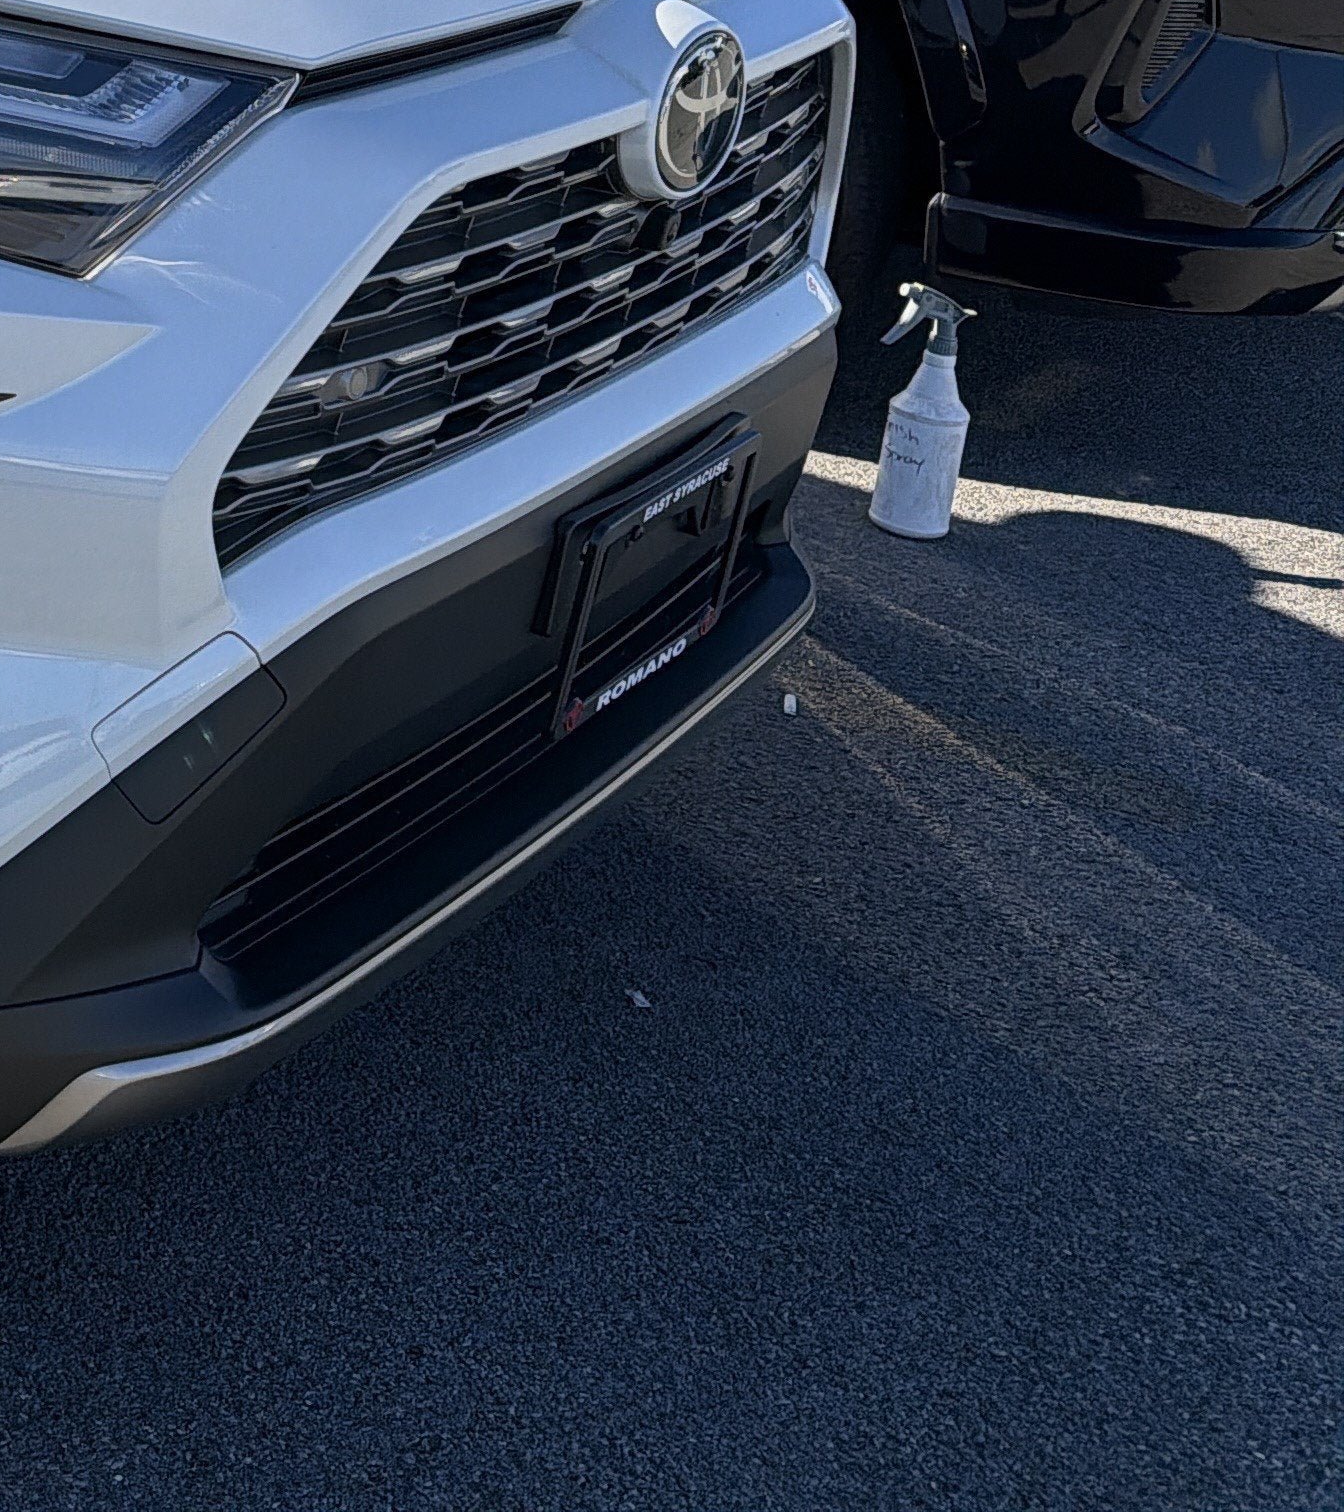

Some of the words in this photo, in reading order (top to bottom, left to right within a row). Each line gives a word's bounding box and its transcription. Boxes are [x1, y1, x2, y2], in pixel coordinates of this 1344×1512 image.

[643, 492, 675, 523] EAST
[672, 456, 731, 504] SYRACUSE
[595, 637, 688, 713] ROMANO
